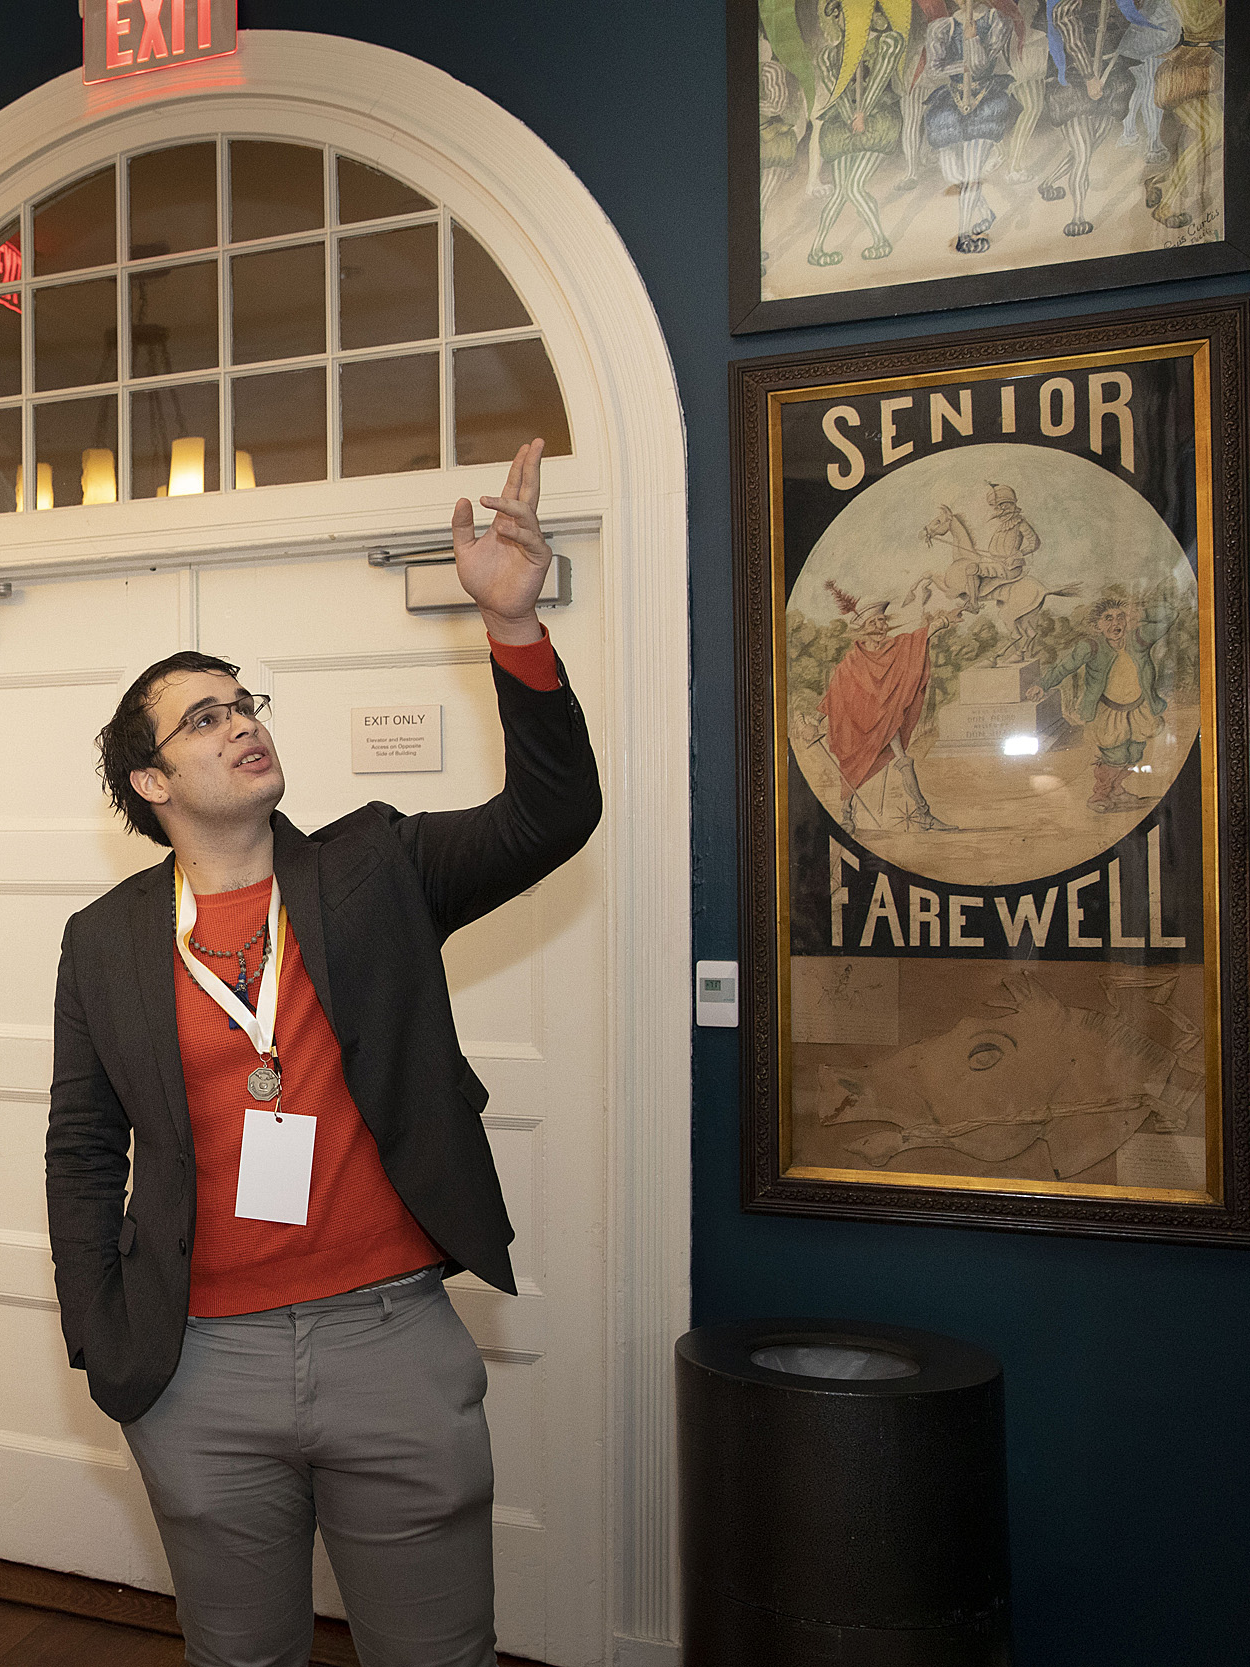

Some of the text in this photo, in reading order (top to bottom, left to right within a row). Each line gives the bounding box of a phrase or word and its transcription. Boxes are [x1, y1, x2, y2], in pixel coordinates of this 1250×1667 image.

[106, 0, 211, 70] EXIT
[822, 370, 1135, 491] SENIOR
[364, 714, 426, 726] EXIT ONLY
[828, 824, 1187, 948] FAREWELL
